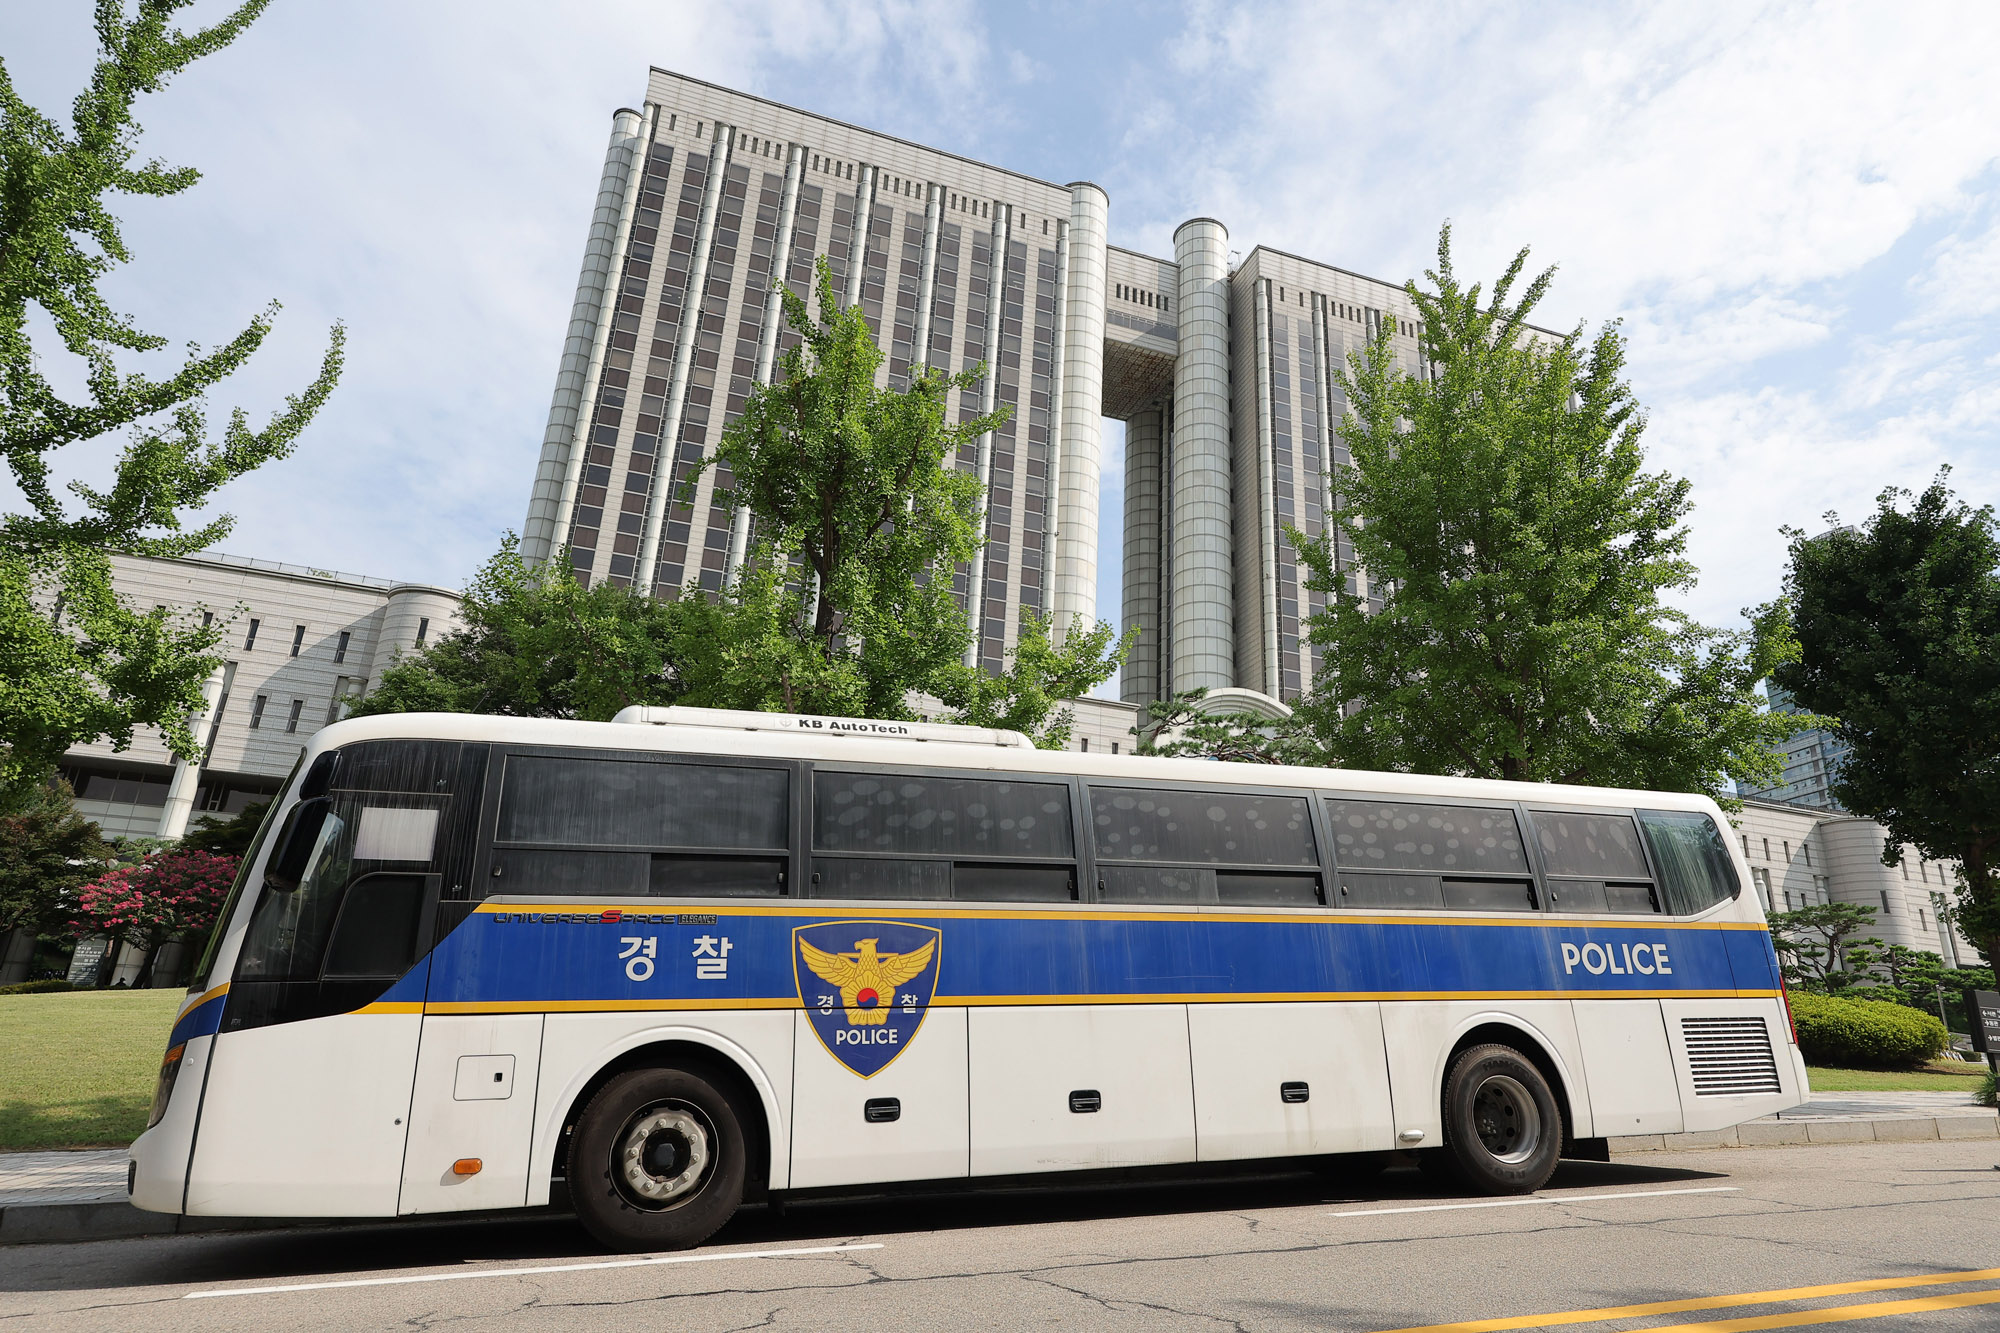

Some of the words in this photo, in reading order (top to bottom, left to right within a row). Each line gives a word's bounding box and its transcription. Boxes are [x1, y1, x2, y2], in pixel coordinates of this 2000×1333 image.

[798, 719, 823, 729] KB
[829, 721, 908, 734] AutoTech
[618, 936, 658, 982] 경
[692, 935, 733, 980] 찰
[1560, 942, 1673, 975] POLICE
[817, 995, 834, 1015] 경
[901, 994, 918, 1014] 찰
[836, 1029, 898, 1045] POLICE
